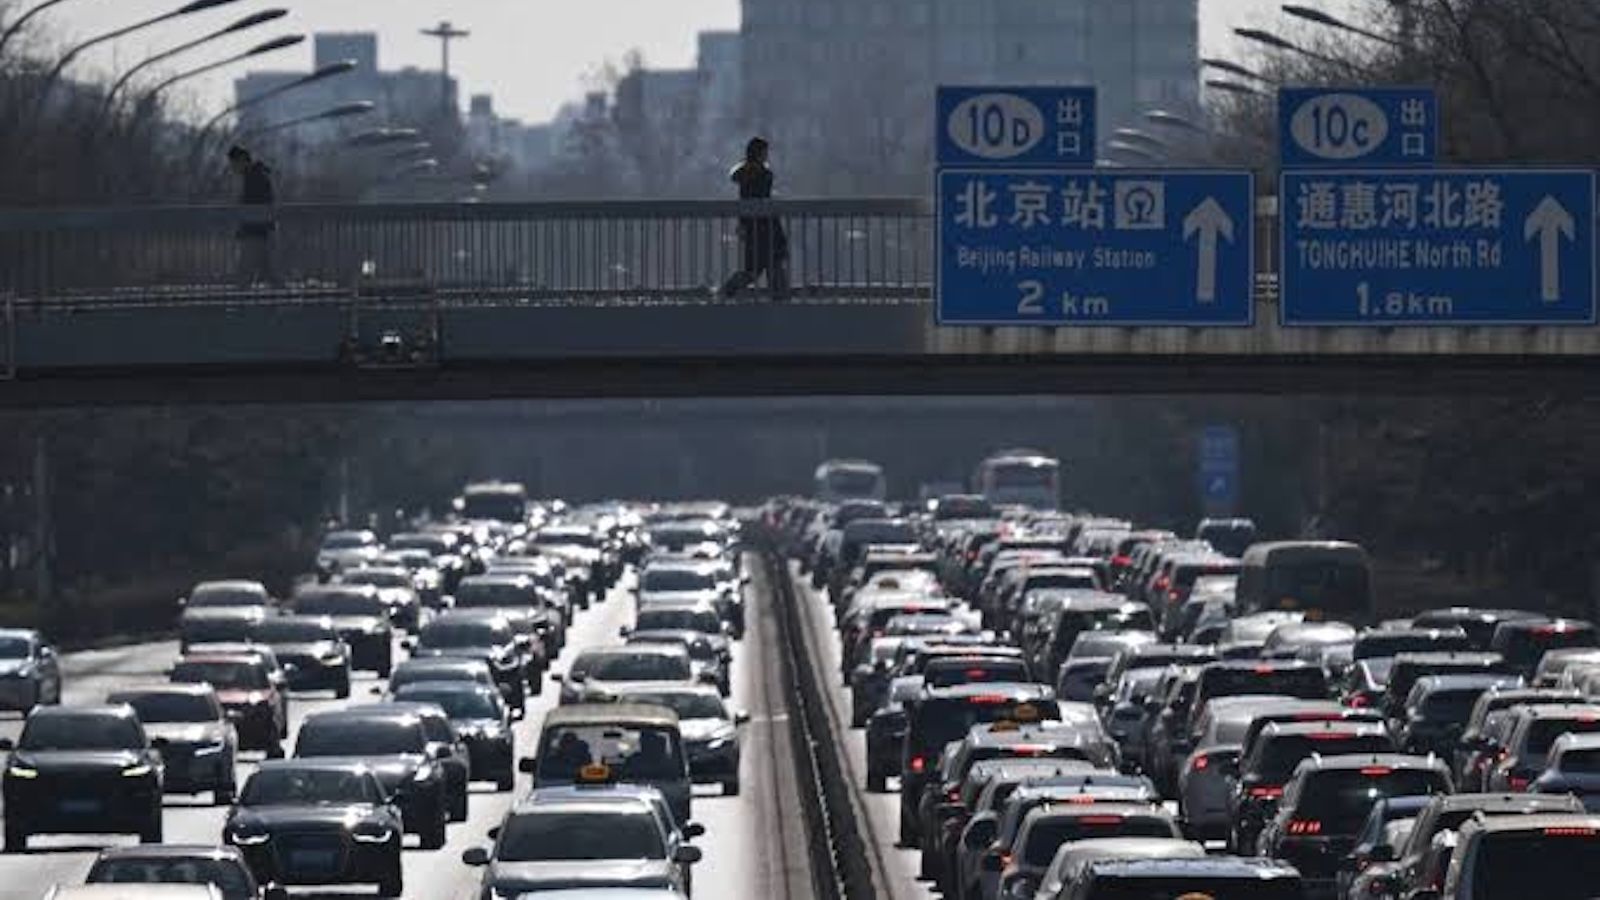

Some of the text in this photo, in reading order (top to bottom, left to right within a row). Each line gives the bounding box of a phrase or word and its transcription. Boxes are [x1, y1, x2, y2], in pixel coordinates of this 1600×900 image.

[1057, 97, 1082, 155] 出口
[1400, 98, 1425, 155] 出口
[955, 180, 1107, 229] 北京站
[1297, 180, 1504, 229] 通惠河北路
[958, 246, 1155, 273] Beijing Railway Station
[1297, 239, 1501, 268] TONGHUIHE North Rd
[1017, 280, 1109, 314] 2 km
